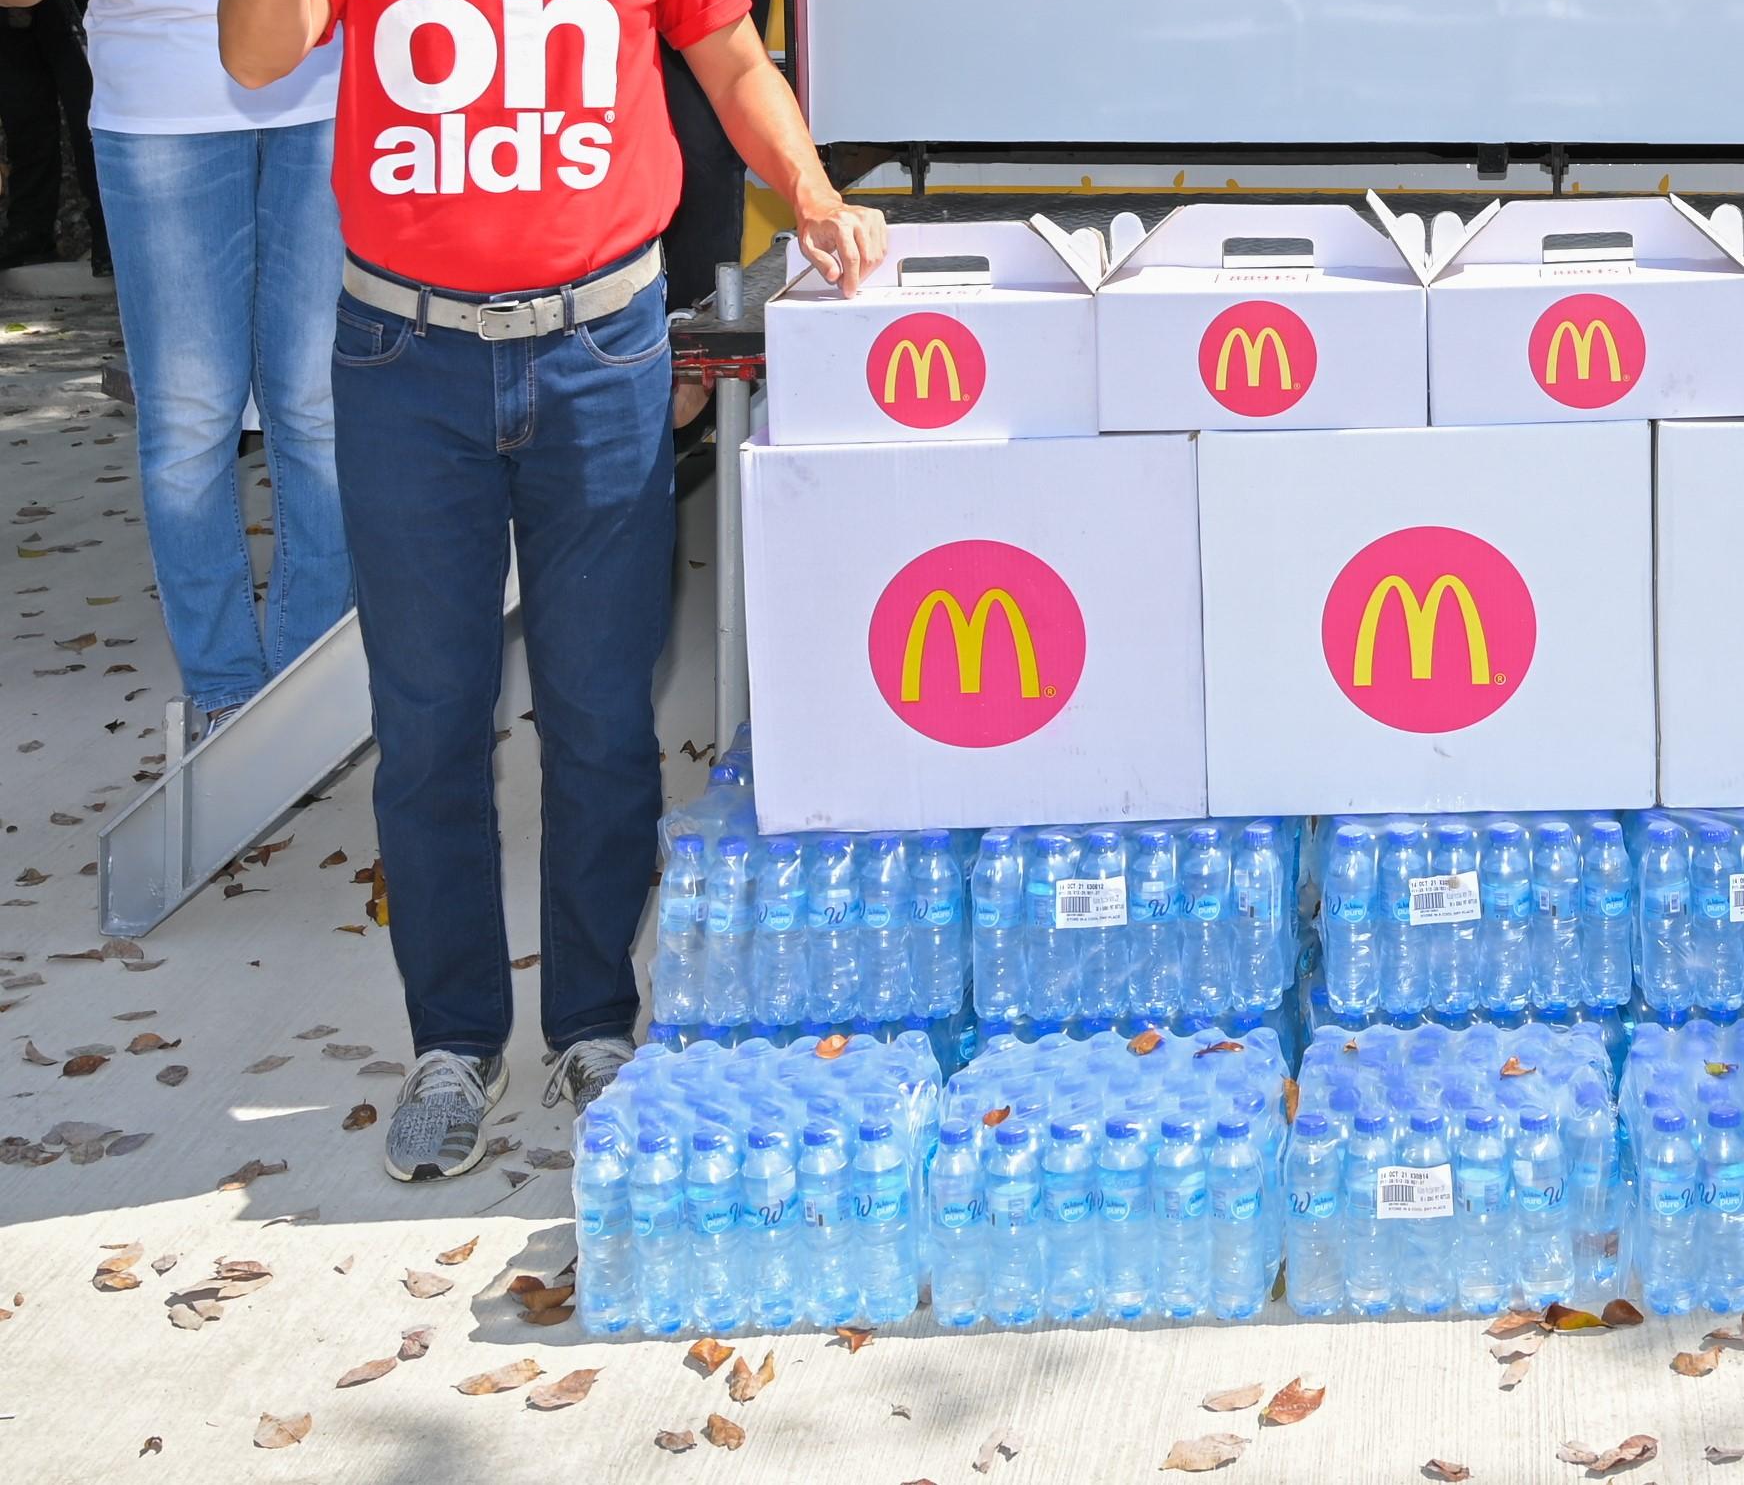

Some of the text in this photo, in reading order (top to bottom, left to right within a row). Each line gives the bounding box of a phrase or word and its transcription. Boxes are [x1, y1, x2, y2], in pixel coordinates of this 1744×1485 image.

[369, 110, 614, 196] ald's
[1659, 1200, 1680, 1210] pure
[1720, 1197, 1740, 1207] pure
